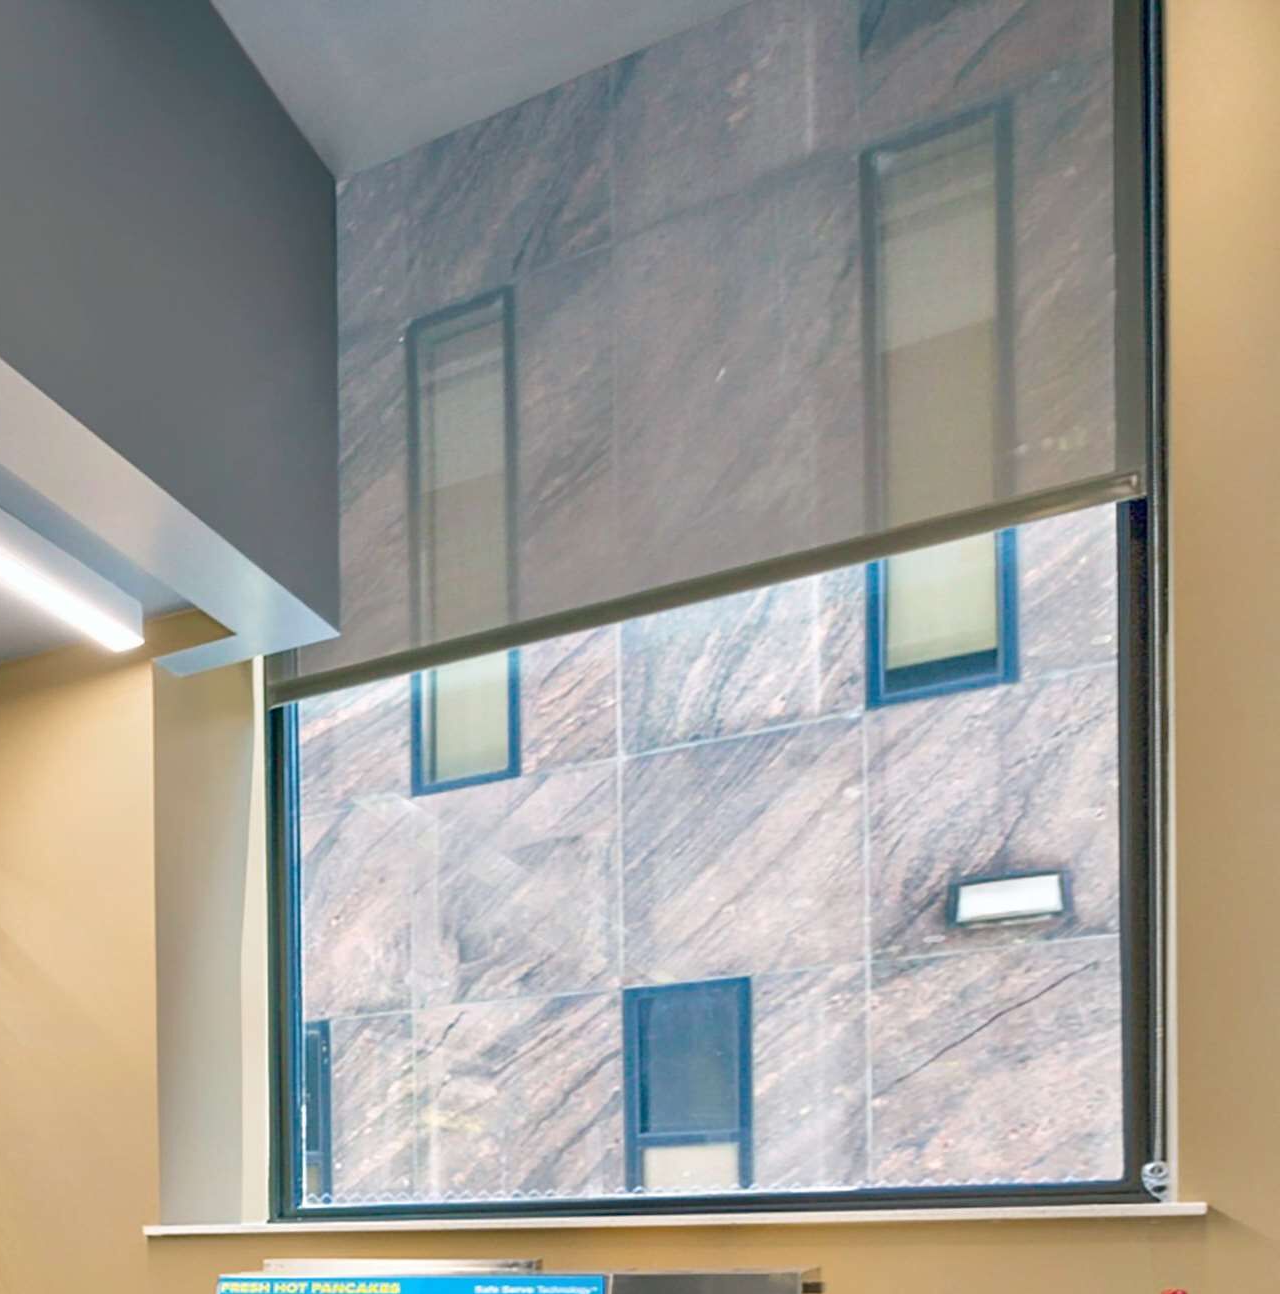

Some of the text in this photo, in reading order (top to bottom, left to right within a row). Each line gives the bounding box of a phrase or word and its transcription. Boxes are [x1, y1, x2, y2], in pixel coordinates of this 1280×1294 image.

[221, 1281, 401, 1294] FRESH HOT PANCAKES
[474, 1285, 499, 1294] Safe
